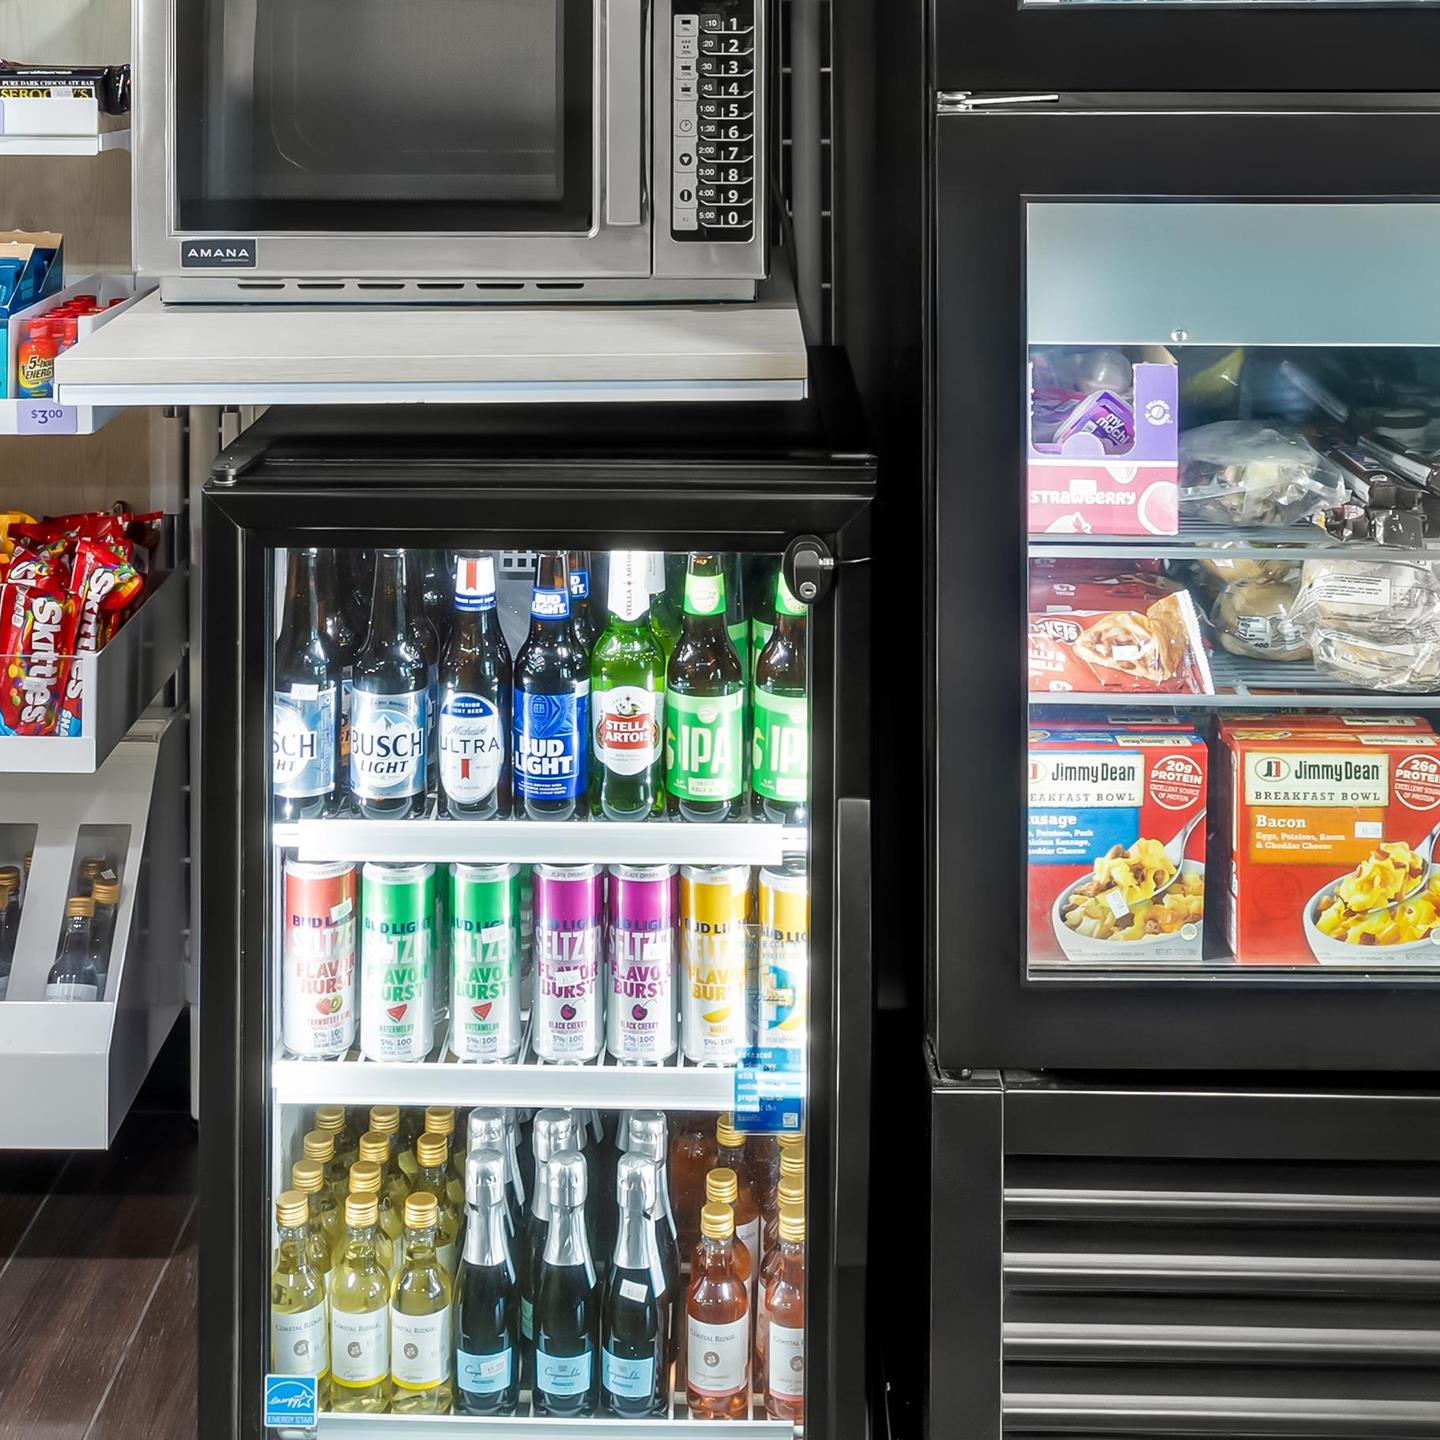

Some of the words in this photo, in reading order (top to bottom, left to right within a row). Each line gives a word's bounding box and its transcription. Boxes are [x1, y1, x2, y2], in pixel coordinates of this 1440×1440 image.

[730, 18, 737, 30] 1
[729, 40, 738, 52] 2
[729, 61, 738, 74] 3
[729, 82, 738, 94] 4
[729, 104, 738, 116] 5
[729, 126, 738, 138] 6
[729, 148, 738, 160] 7
[729, 169, 738, 181] 8
[729, 190, 738, 202] 9
[729, 212, 738, 224] 0
[188, 248, 249, 257] AMANA
[21, 598, 62, 723] Skittles
[606, 720, 650, 732] STELLA
[352, 727, 424, 760] BUSCH
[604, 732, 652, 743] ARTOIS
[440, 738, 500, 753] ULTRA
[519, 737, 564, 758] BUD
[681, 725, 732, 774] IPA
[360, 760, 409, 774] LIGHT
[515, 752, 573, 776] LIGHT
[1166, 760, 1193, 773] 20g
[1410, 760, 1437, 772] 26g
[1052, 763, 1099, 783] Jimmy
[1101, 763, 1135, 781] Dean
[1151, 770, 1202, 785] PROTEIN
[1295, 761, 1343, 782] Jimmy
[1345, 761, 1379, 780] Dean
[1255, 792, 1335, 801] BREAKFAST
[1342, 792, 1380, 801] BOWL
[1255, 814, 1306, 828] Bacon
